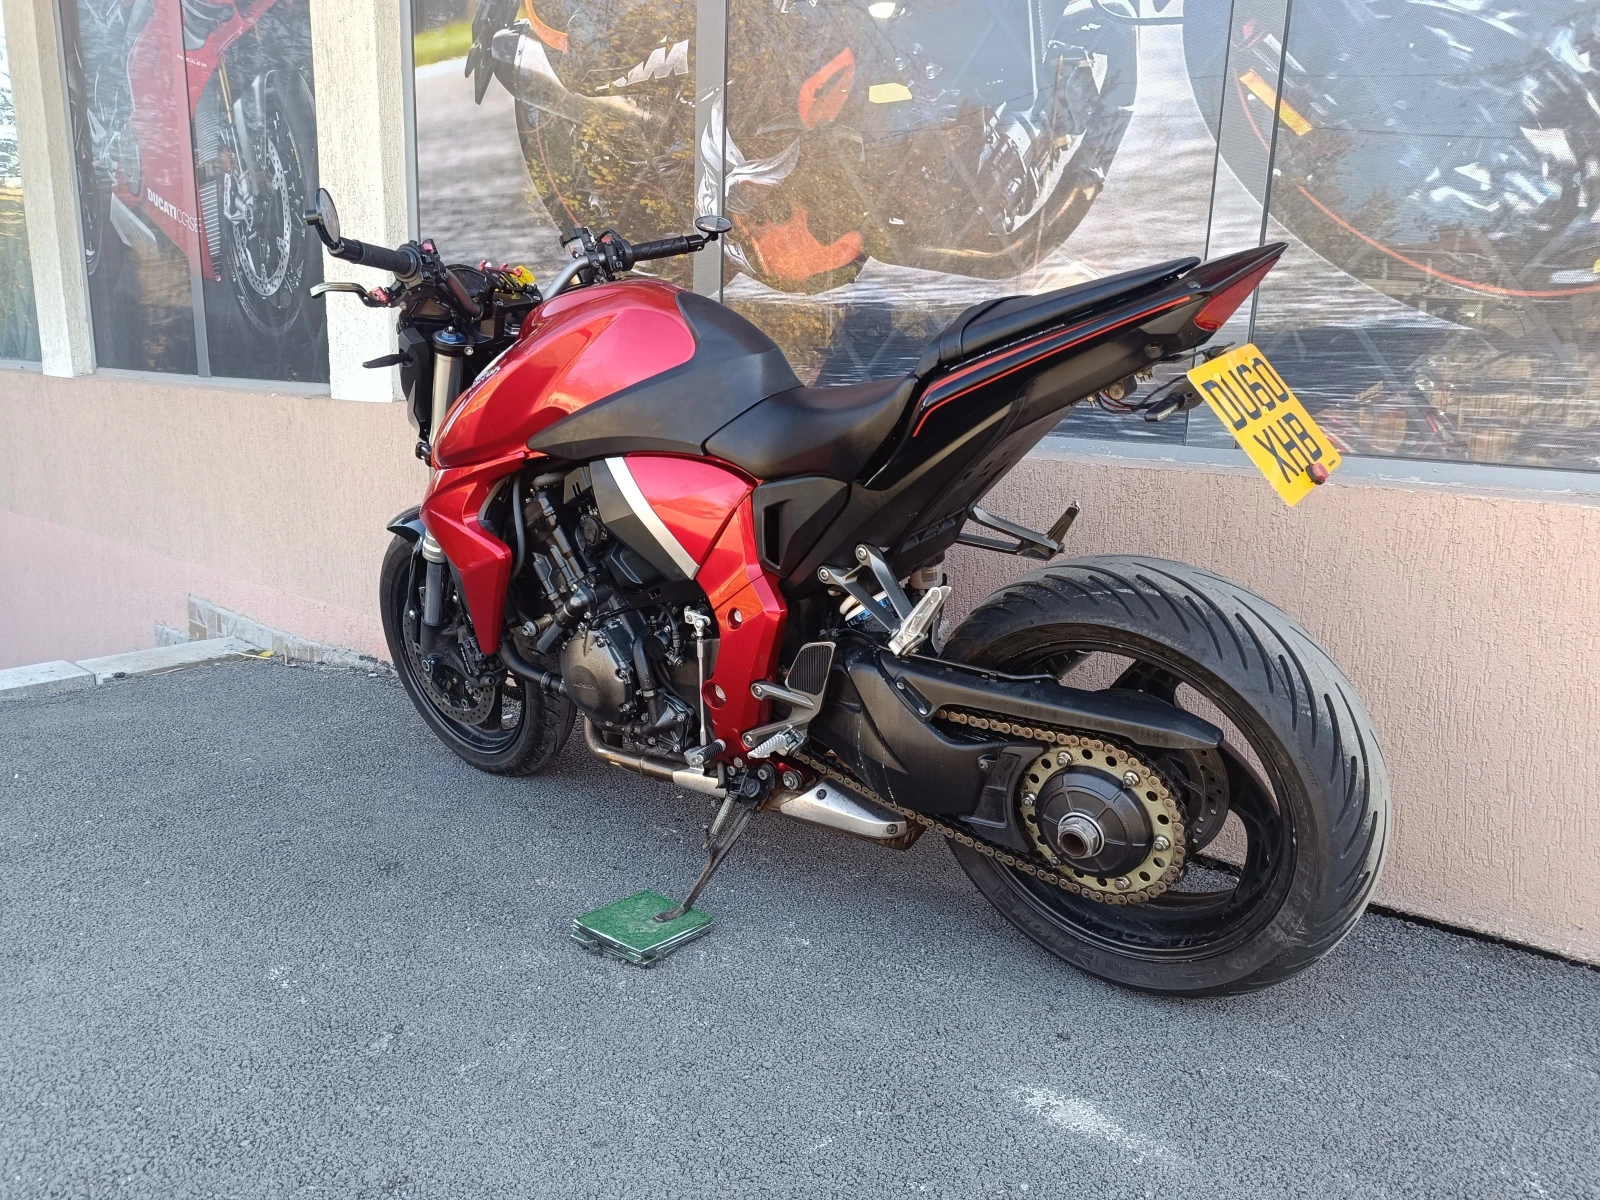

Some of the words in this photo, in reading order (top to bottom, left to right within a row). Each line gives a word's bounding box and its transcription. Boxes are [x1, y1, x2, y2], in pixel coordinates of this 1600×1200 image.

[147, 187, 177, 220] DUCATI
[1201, 357, 1289, 431] DU60
[1252, 412, 1323, 484] XHB
[1299, 755, 1319, 788] SPIRIT
